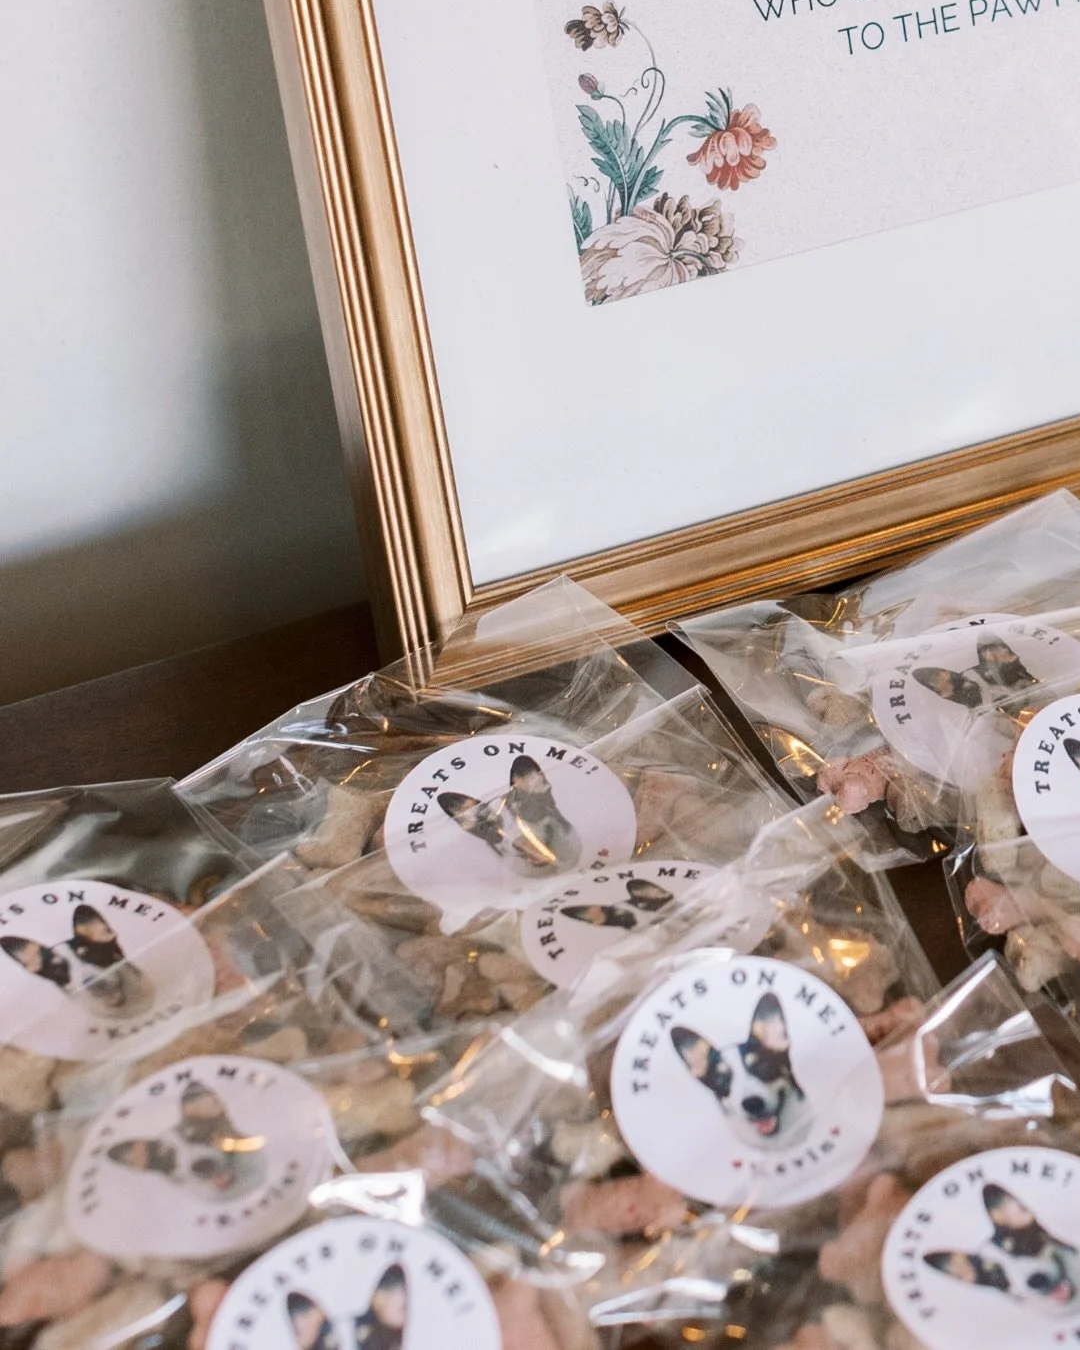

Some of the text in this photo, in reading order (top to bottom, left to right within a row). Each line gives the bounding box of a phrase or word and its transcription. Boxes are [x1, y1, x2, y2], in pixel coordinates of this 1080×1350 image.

[837, 21, 885, 56] TO
[892, 2, 961, 43] THE
[408, 741, 600, 854] TREATS ON ME!
[593, 869, 635, 884] ON
[41, 890, 165, 922] ON ME!
[632, 968, 847, 1094] TREATS ON ME!
